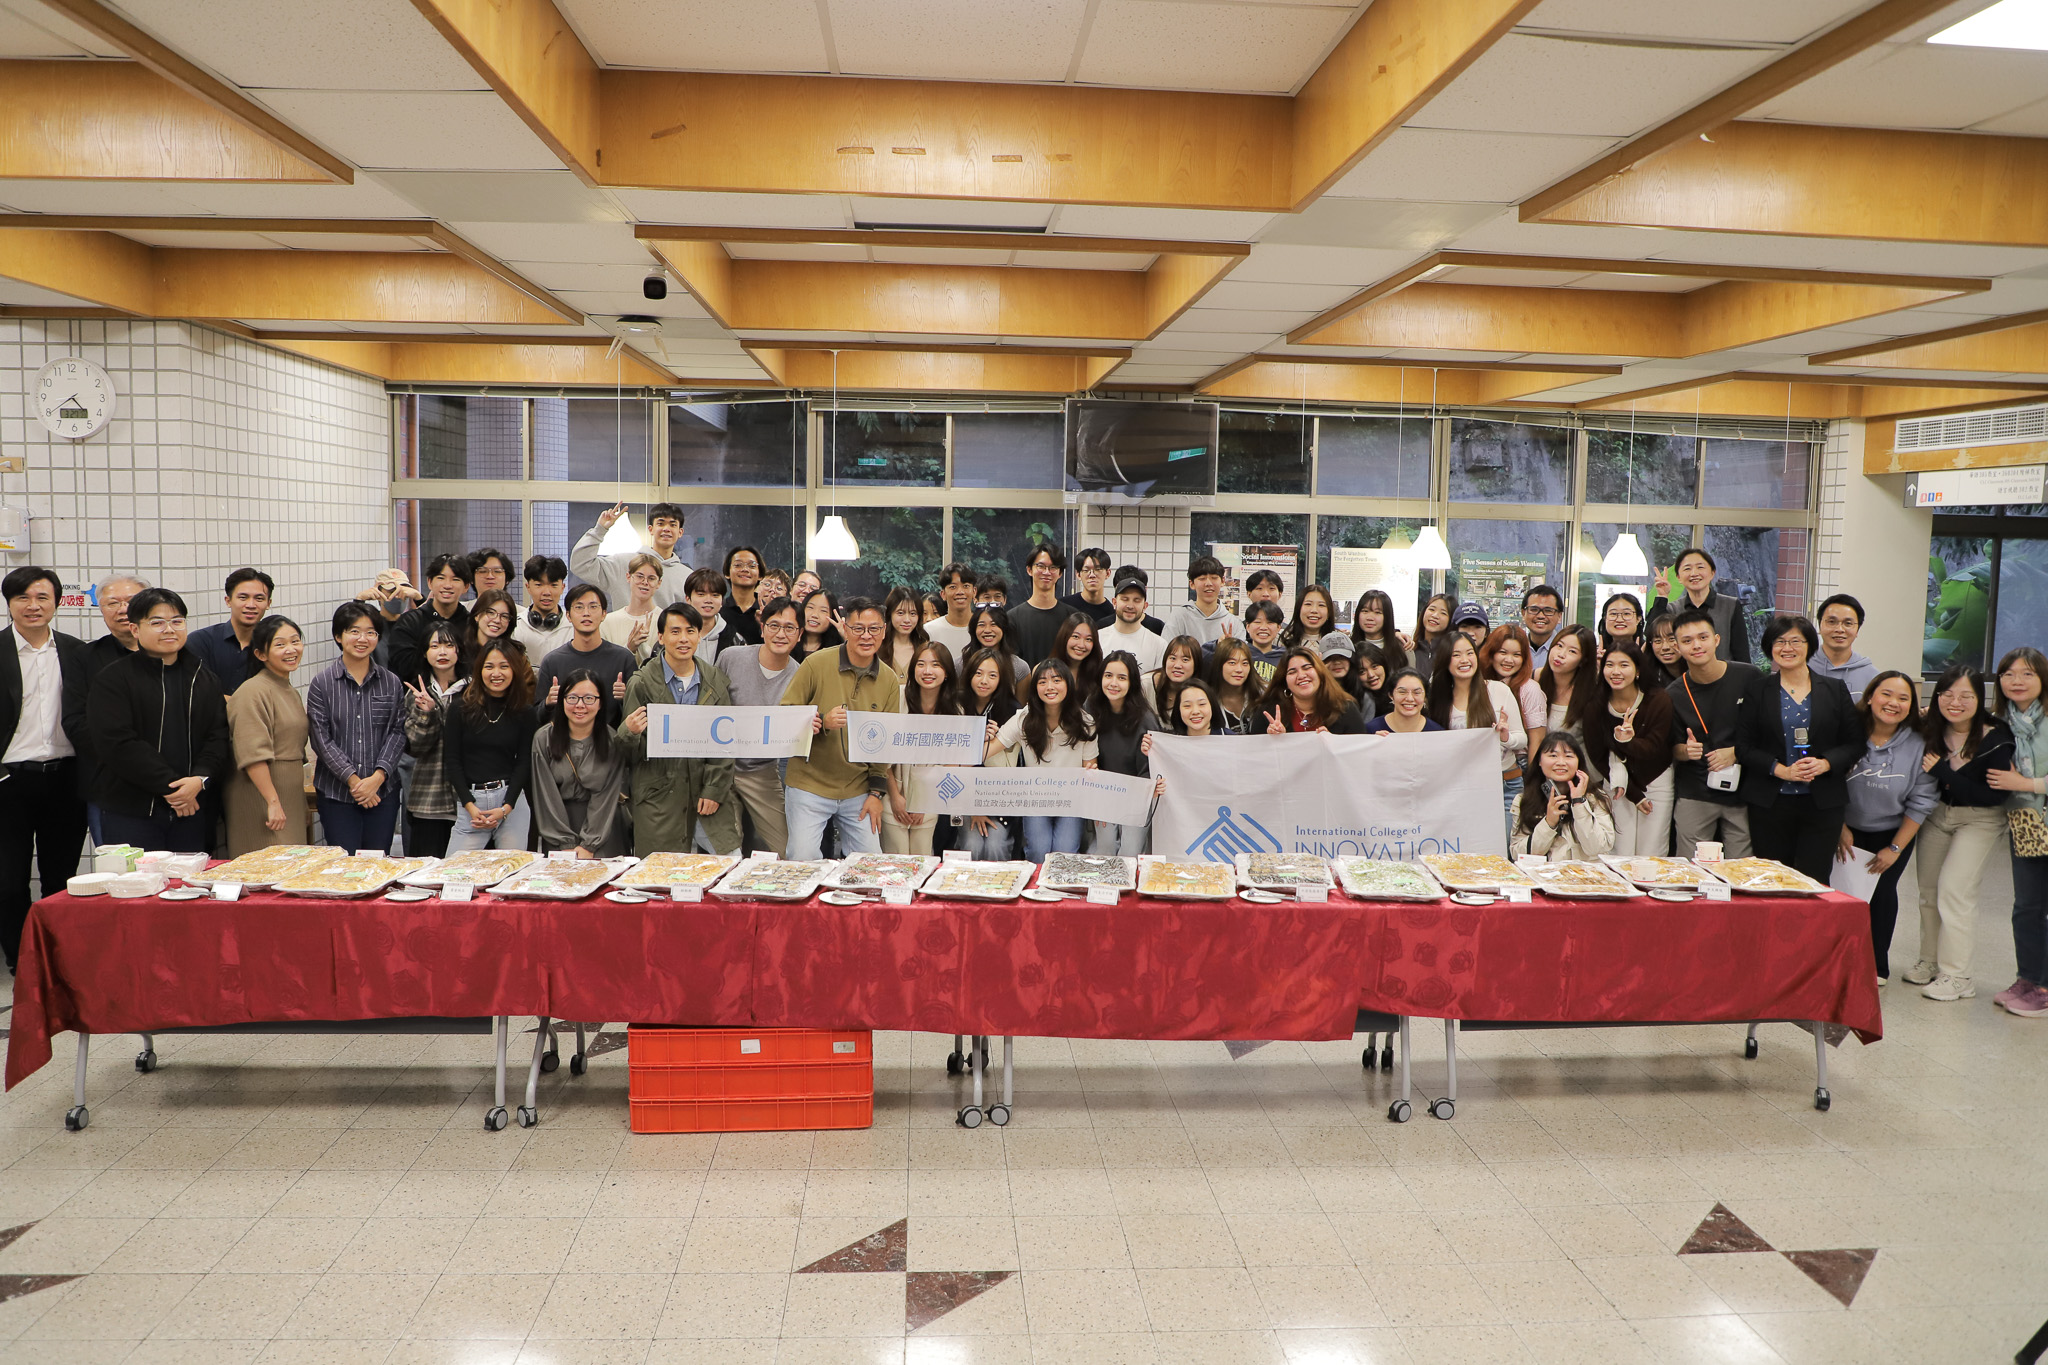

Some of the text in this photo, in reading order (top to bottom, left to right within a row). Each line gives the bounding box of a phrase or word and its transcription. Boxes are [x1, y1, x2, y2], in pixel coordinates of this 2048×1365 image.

[54, 367, 61, 376] 11
[67, 364, 76, 372] 12
[42, 378, 52, 387] 10
[95, 379, 101, 388] 2
[40, 393, 46, 402] 9
[100, 394, 105, 402] 3
[46, 408, 51, 417] 8
[96, 408, 102, 416] 4
[56, 420, 62, 428] 7
[72, 424, 78, 432] 6
[86, 420, 93, 429] 5
[58, 595, 85, 606] 勿吸煙
[892, 732, 971, 748] 創新國際學院
[975, 777, 1127, 793] International College of Innovation
[974, 799, 1072, 808] 國立政治大學創新國際學院
[1296, 825, 1422, 838] International College of
[1295, 837, 1460, 861] INNOVATION
